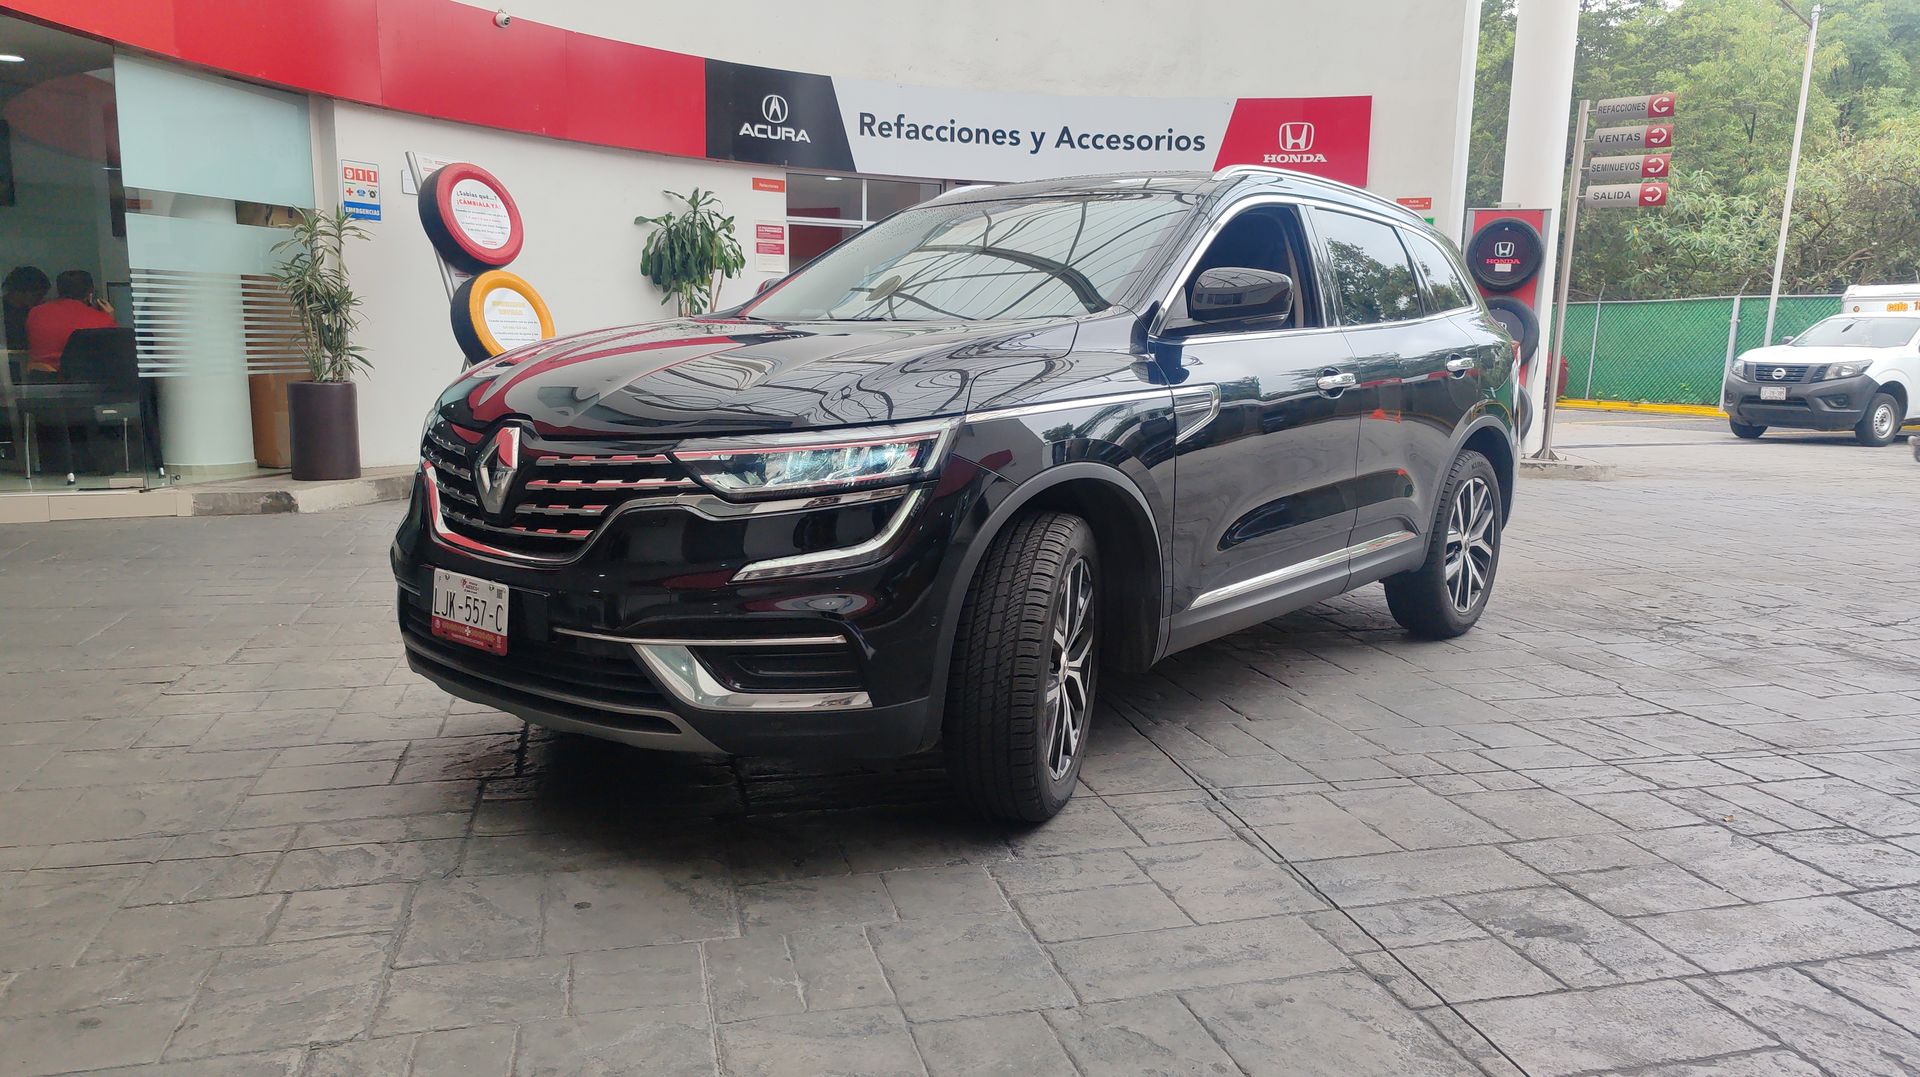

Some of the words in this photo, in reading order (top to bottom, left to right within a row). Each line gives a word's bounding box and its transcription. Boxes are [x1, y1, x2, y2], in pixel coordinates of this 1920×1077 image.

[1598, 102, 1646, 114] REFACCIONES
[738, 122, 811, 143] ACURA
[859, 112, 1021, 146] Refacciones
[1029, 131, 1046, 154] y
[1055, 125, 1206, 151] Accesorios
[1598, 133, 1641, 143] VENTAS
[1263, 154, 1328, 163] HONDA
[1591, 162, 1640, 173] SEMINUEVOS
[345, 168, 376, 182] 911
[1593, 191, 1632, 201] SALIDA
